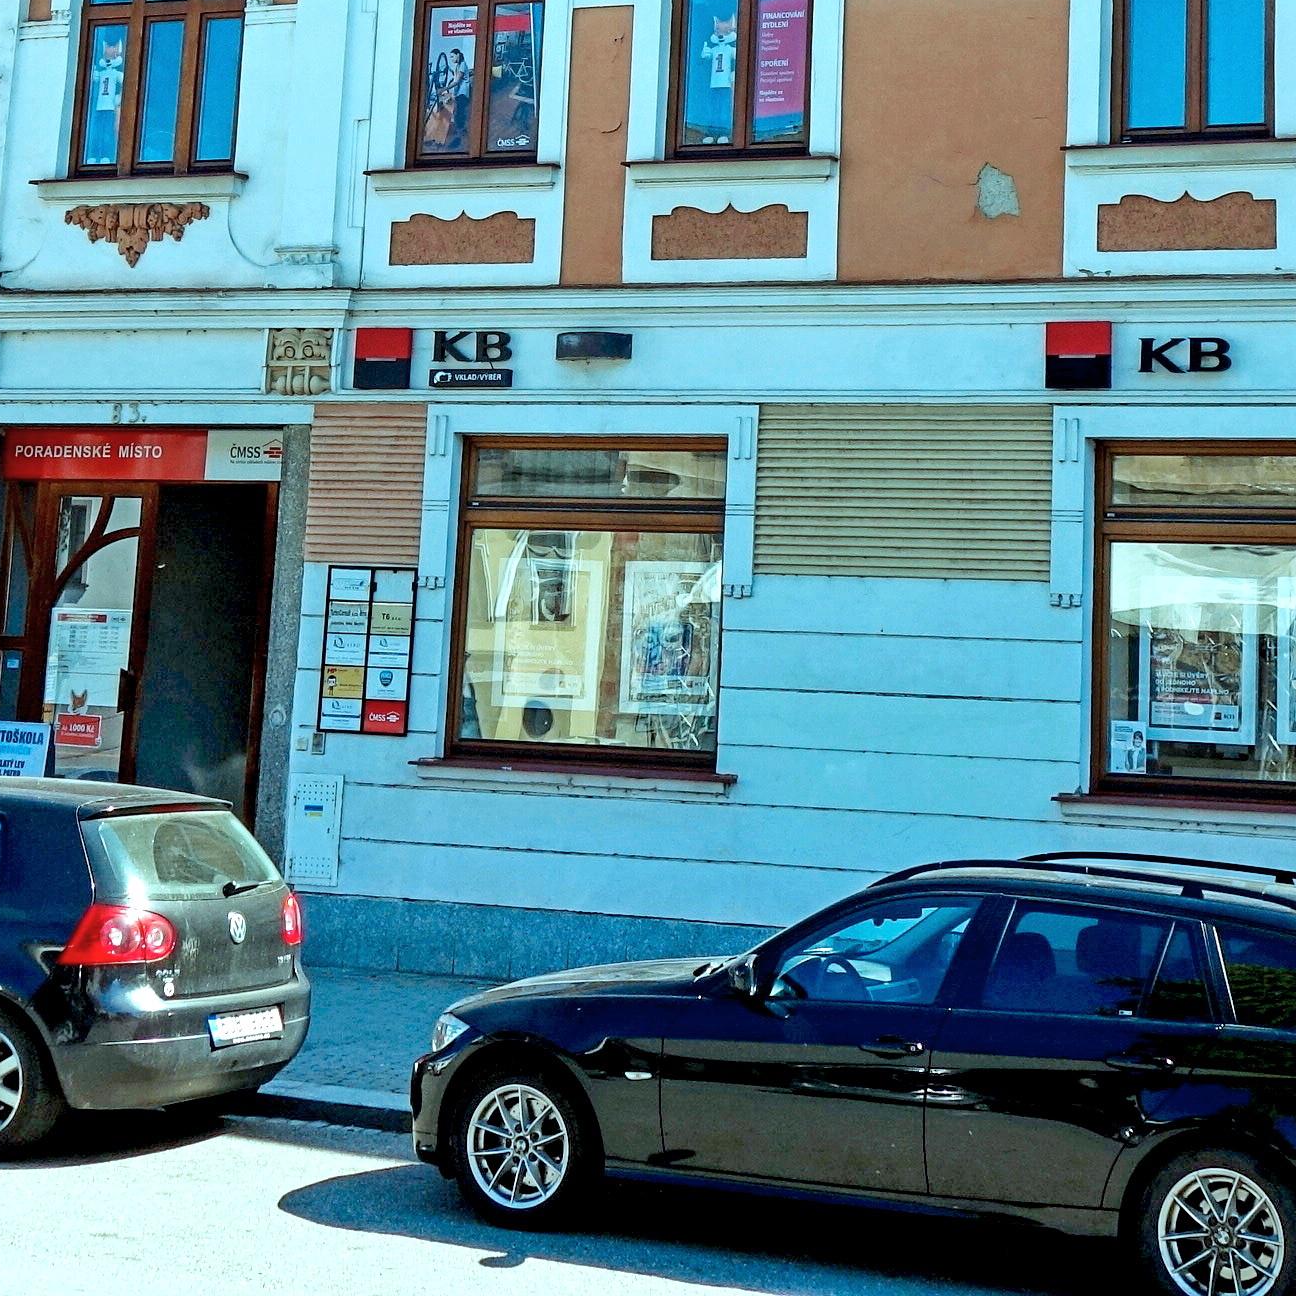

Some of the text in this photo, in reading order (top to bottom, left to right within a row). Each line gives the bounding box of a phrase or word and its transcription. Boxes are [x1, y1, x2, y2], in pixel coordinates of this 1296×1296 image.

[762, 11, 805, 20] FINANCOVÁNÍ
[762, 20, 789, 29] BYDLENÍ
[760, 59, 789, 68] SPOŘENÍ
[497, 138, 515, 148] ČMSS
[432, 331, 512, 362] KB
[1138, 337, 1232, 373] KB
[15, 442, 163, 459] PORADENSKÉ MÍSTO
[230, 443, 261, 459] ČMSS
[369, 712, 386, 722] ČMSS
[69, 724, 85, 733] 1000
[15, 760, 25, 769] LEV
